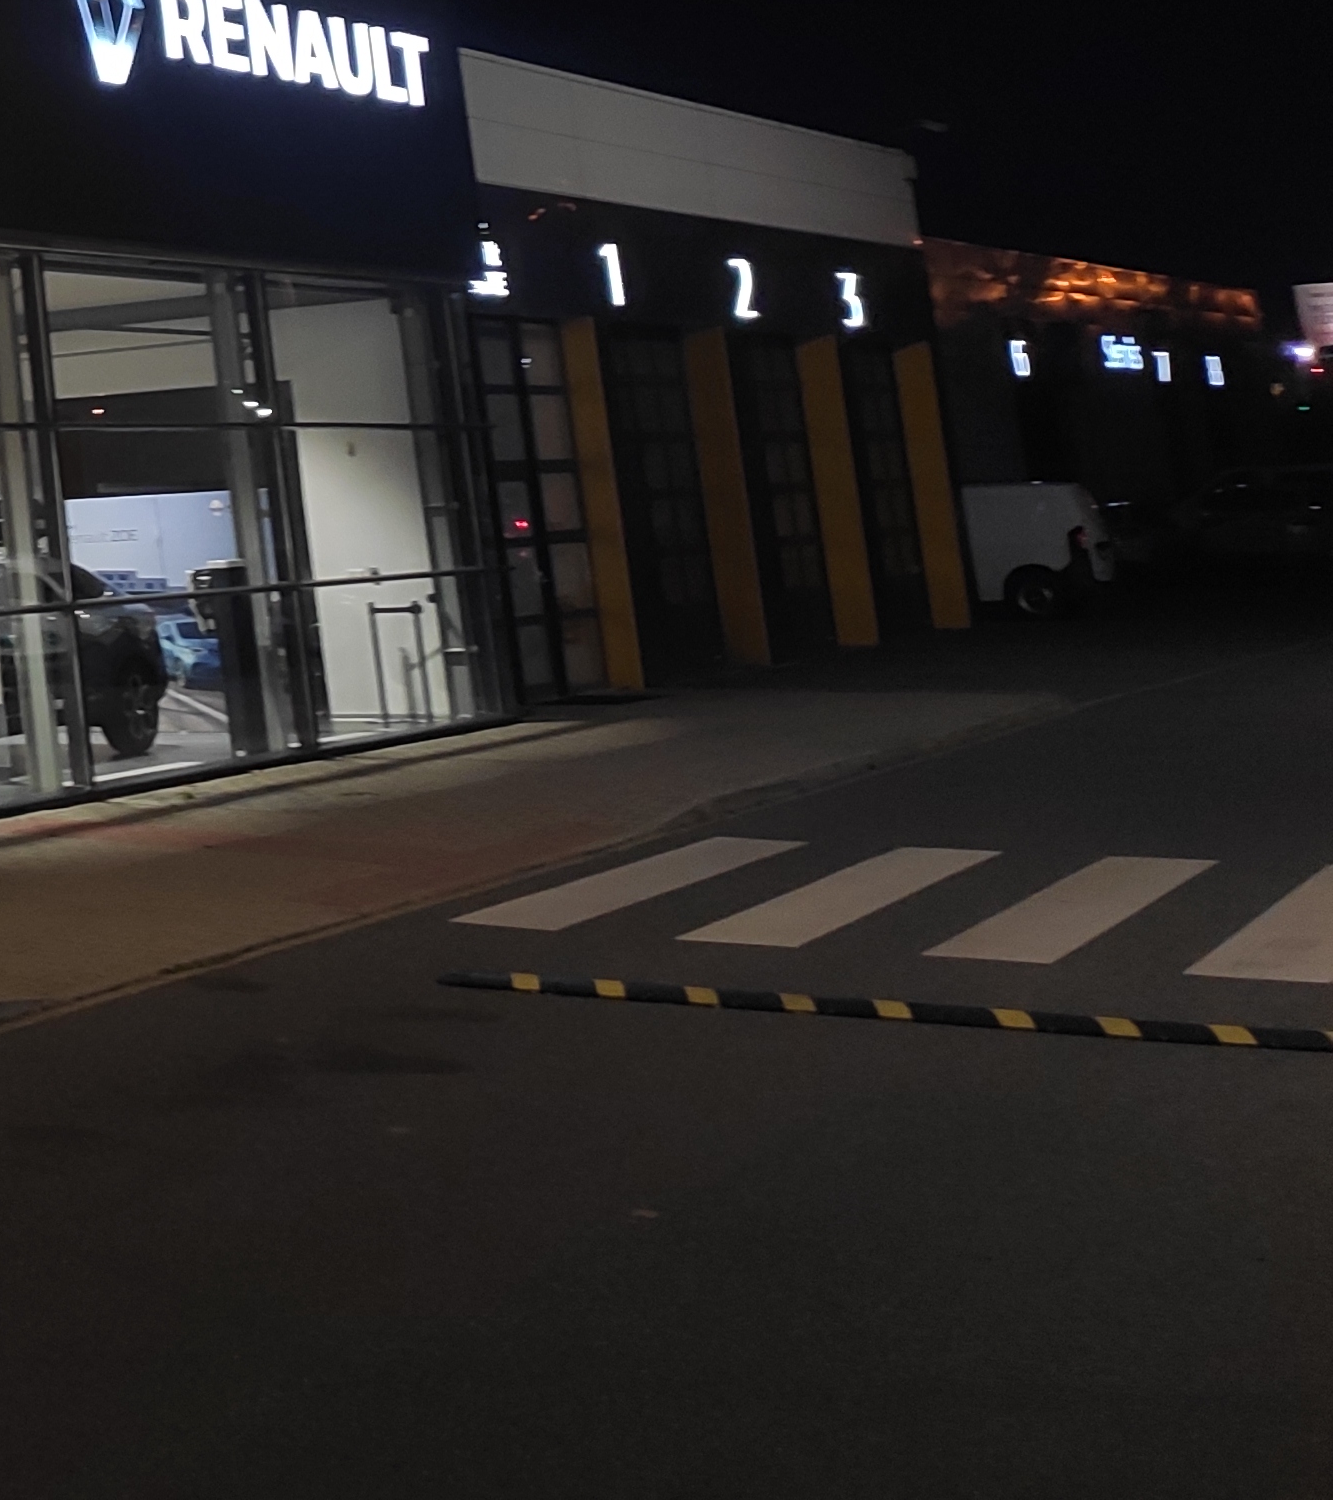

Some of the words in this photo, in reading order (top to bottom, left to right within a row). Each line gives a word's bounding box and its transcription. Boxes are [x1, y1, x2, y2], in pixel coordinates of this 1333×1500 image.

[597, 243, 626, 306] 1
[726, 258, 761, 320] 2
[834, 272, 865, 328] 3
